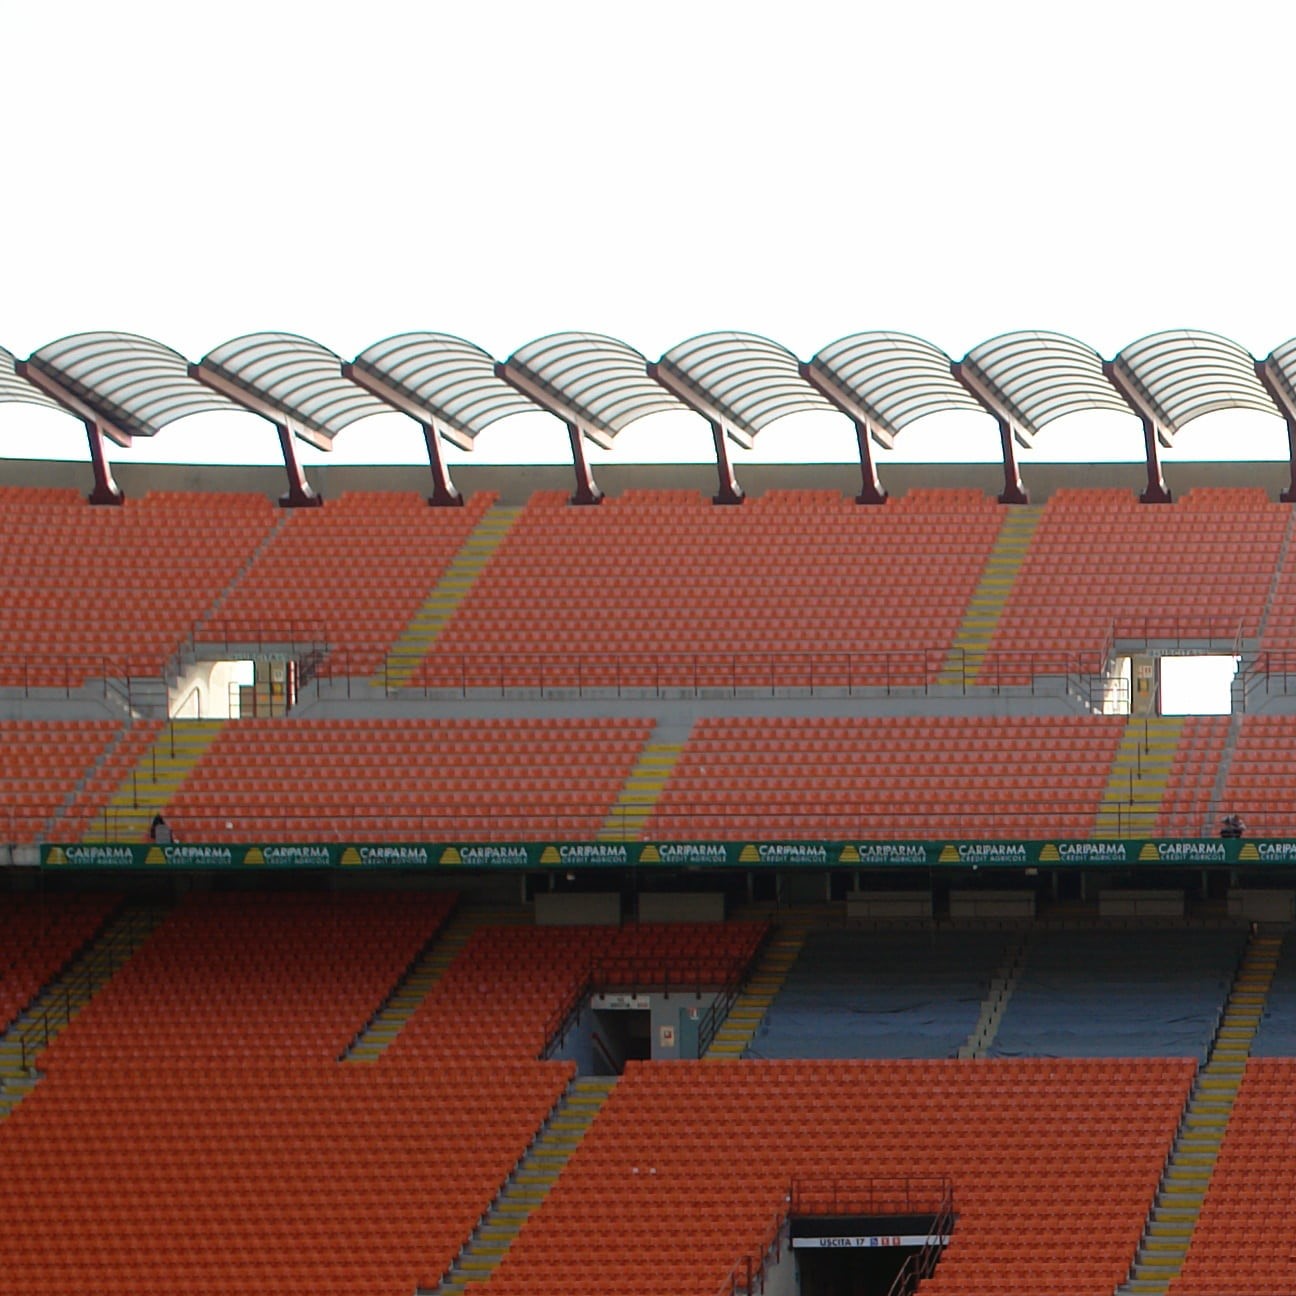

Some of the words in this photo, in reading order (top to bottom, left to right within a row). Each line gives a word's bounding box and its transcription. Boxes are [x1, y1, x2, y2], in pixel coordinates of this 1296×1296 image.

[66, 848, 133, 858] CARIPARMA
[165, 848, 231, 858] CARIPARMA
[263, 848, 329, 857] CARIPARMA
[360, 848, 427, 858] CARIPARMA
[460, 848, 527, 857] CARIPARMA
[560, 846, 627, 856] CARIPARMA
[659, 846, 726, 855] CARIPARMA
[759, 845, 826, 856] CARIPARMA
[859, 846, 926, 856] CARIPARMA
[959, 845, 1026, 855] CARIPARMA
[1059, 844, 1126, 854] CARIPARMA
[1159, 844, 1225, 854] CARIPARMA
[820, 1239, 851, 1247] USCITA
[856, 1238, 865, 1247] 17
